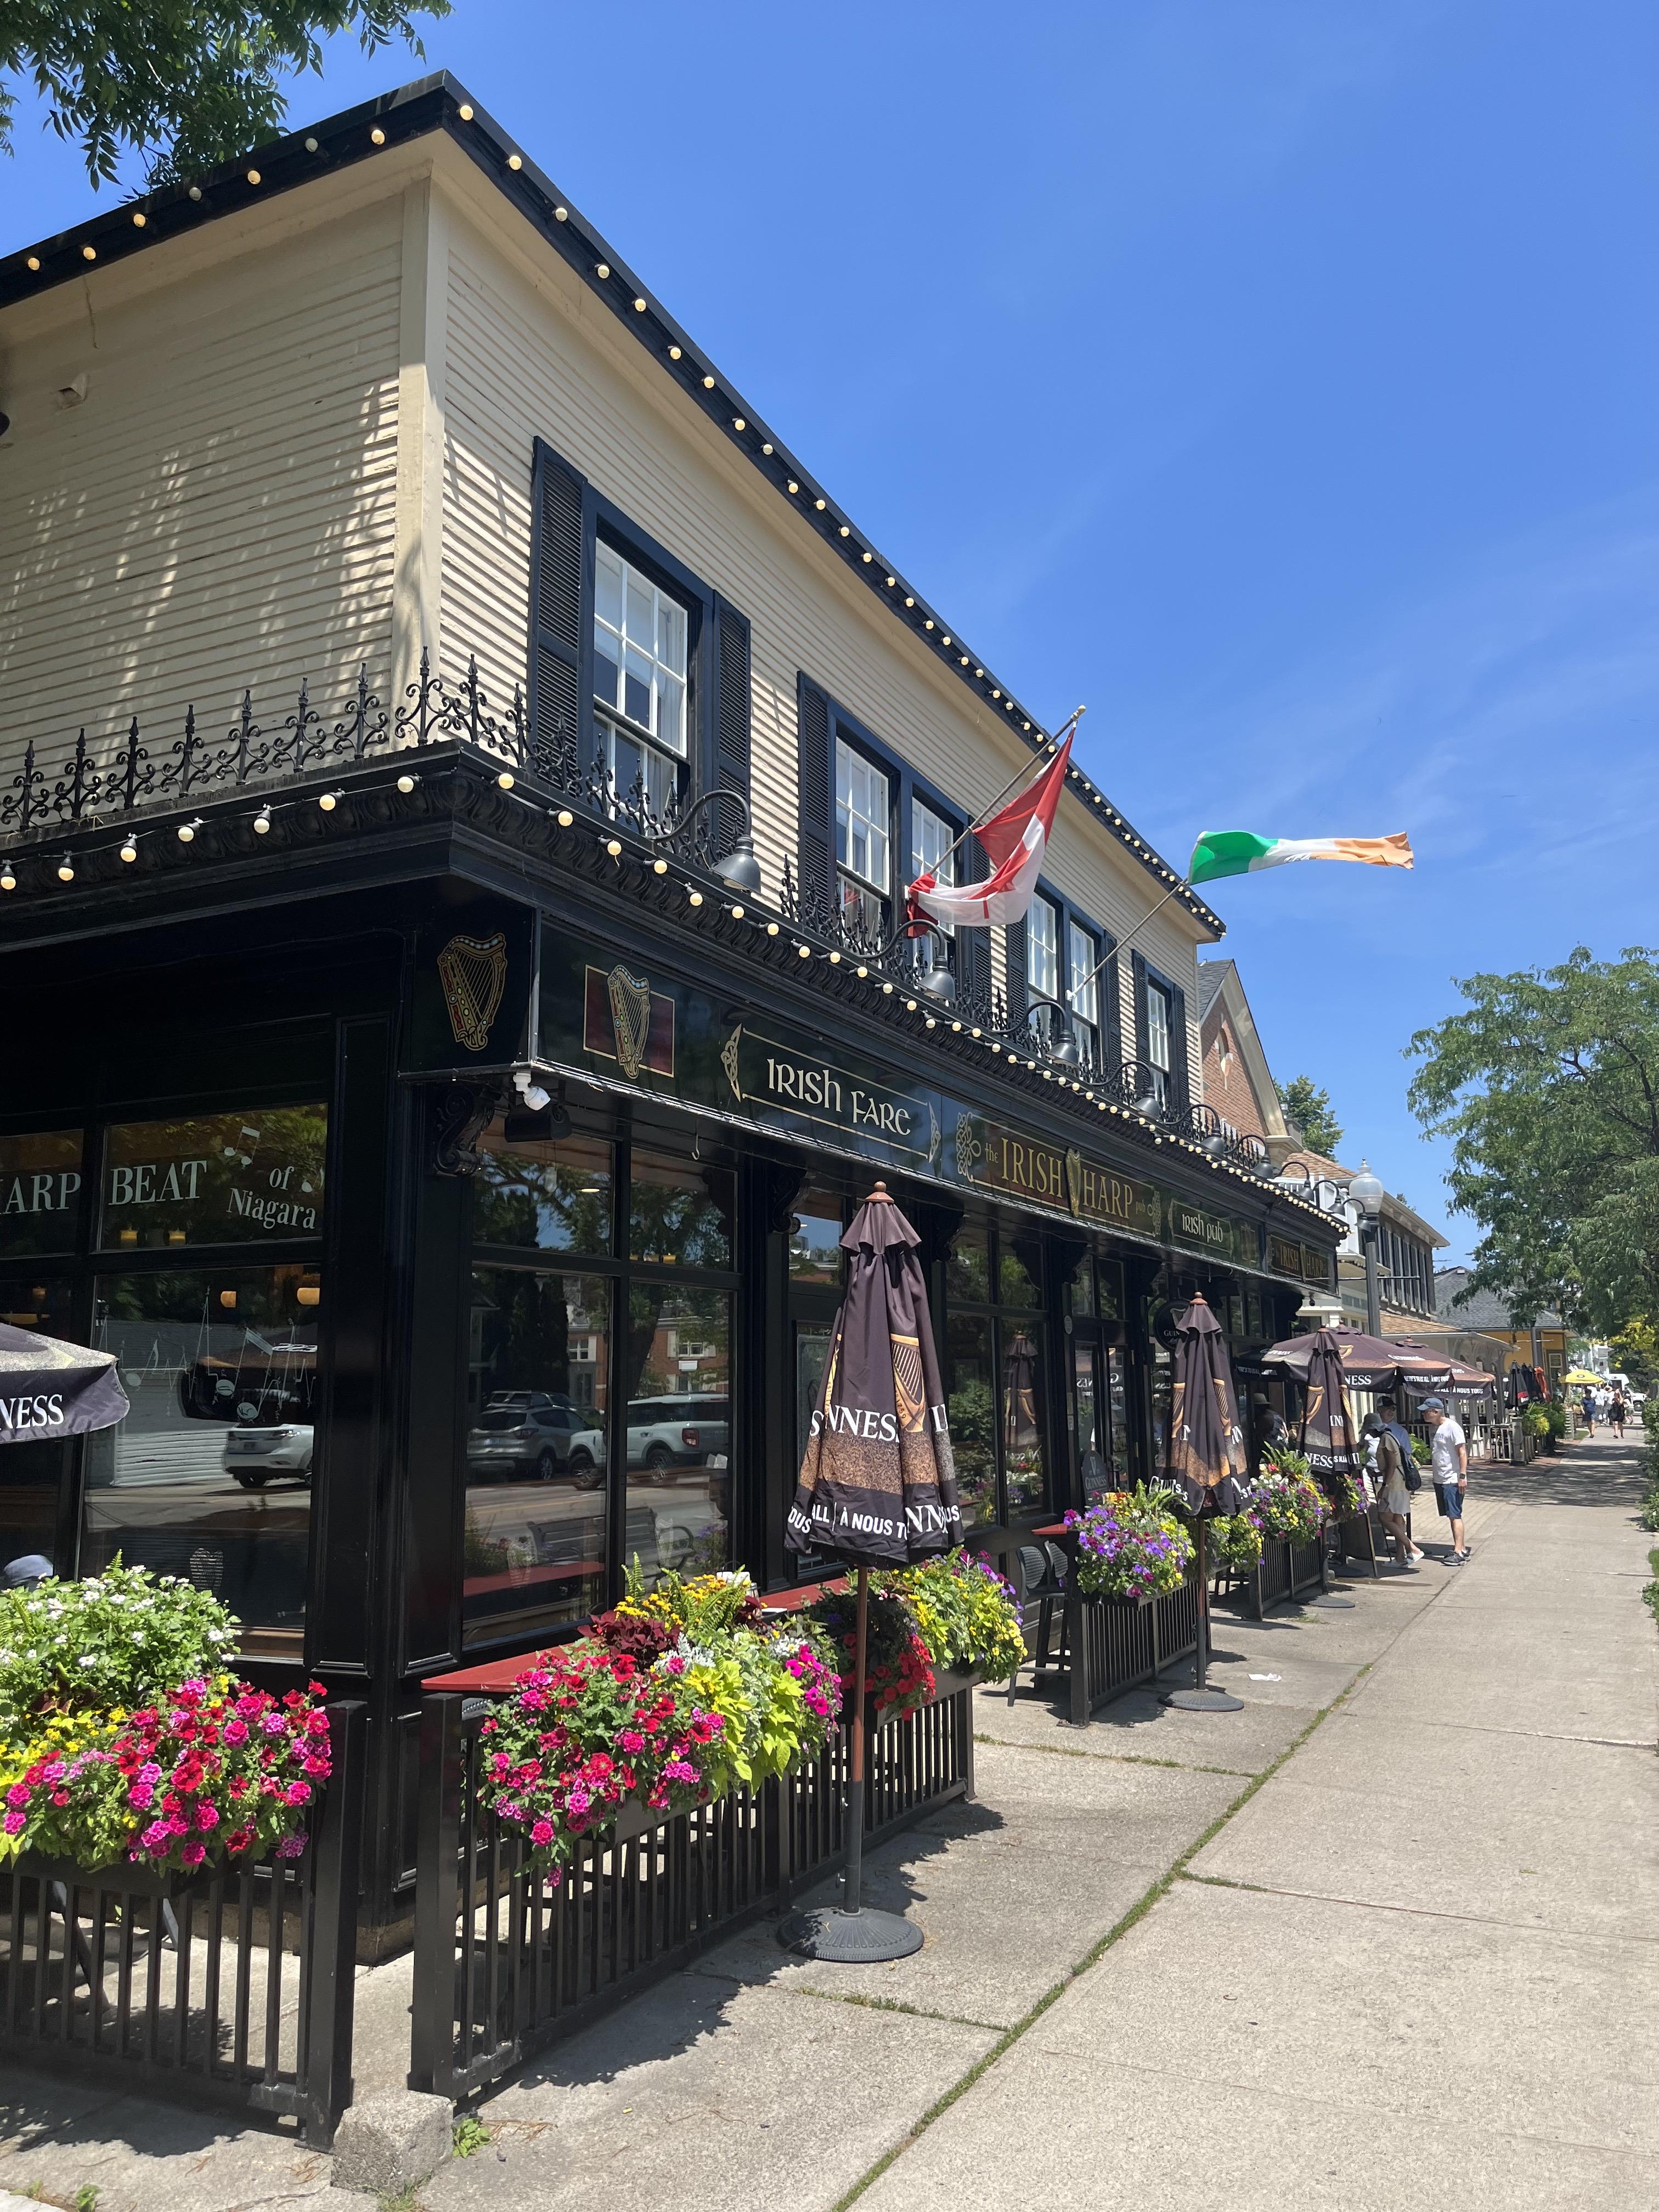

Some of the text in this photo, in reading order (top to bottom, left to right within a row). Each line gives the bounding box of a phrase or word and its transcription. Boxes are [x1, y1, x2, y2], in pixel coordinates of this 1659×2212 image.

[0, 1160, 207, 1215] ARP BEAT
[269, 1166, 295, 1190] of
[985, 1137, 1146, 1219] the IRISH HARP pub
[225, 1188, 316, 1229] Niagara
[1280, 1245, 1299, 1271] IRISH
[1306, 1255, 1323, 1278] HARP
[788, 1505, 812, 1533] OUS
[839, 1506, 849, 1527] À
[851, 1513, 894, 1536] NOUS
